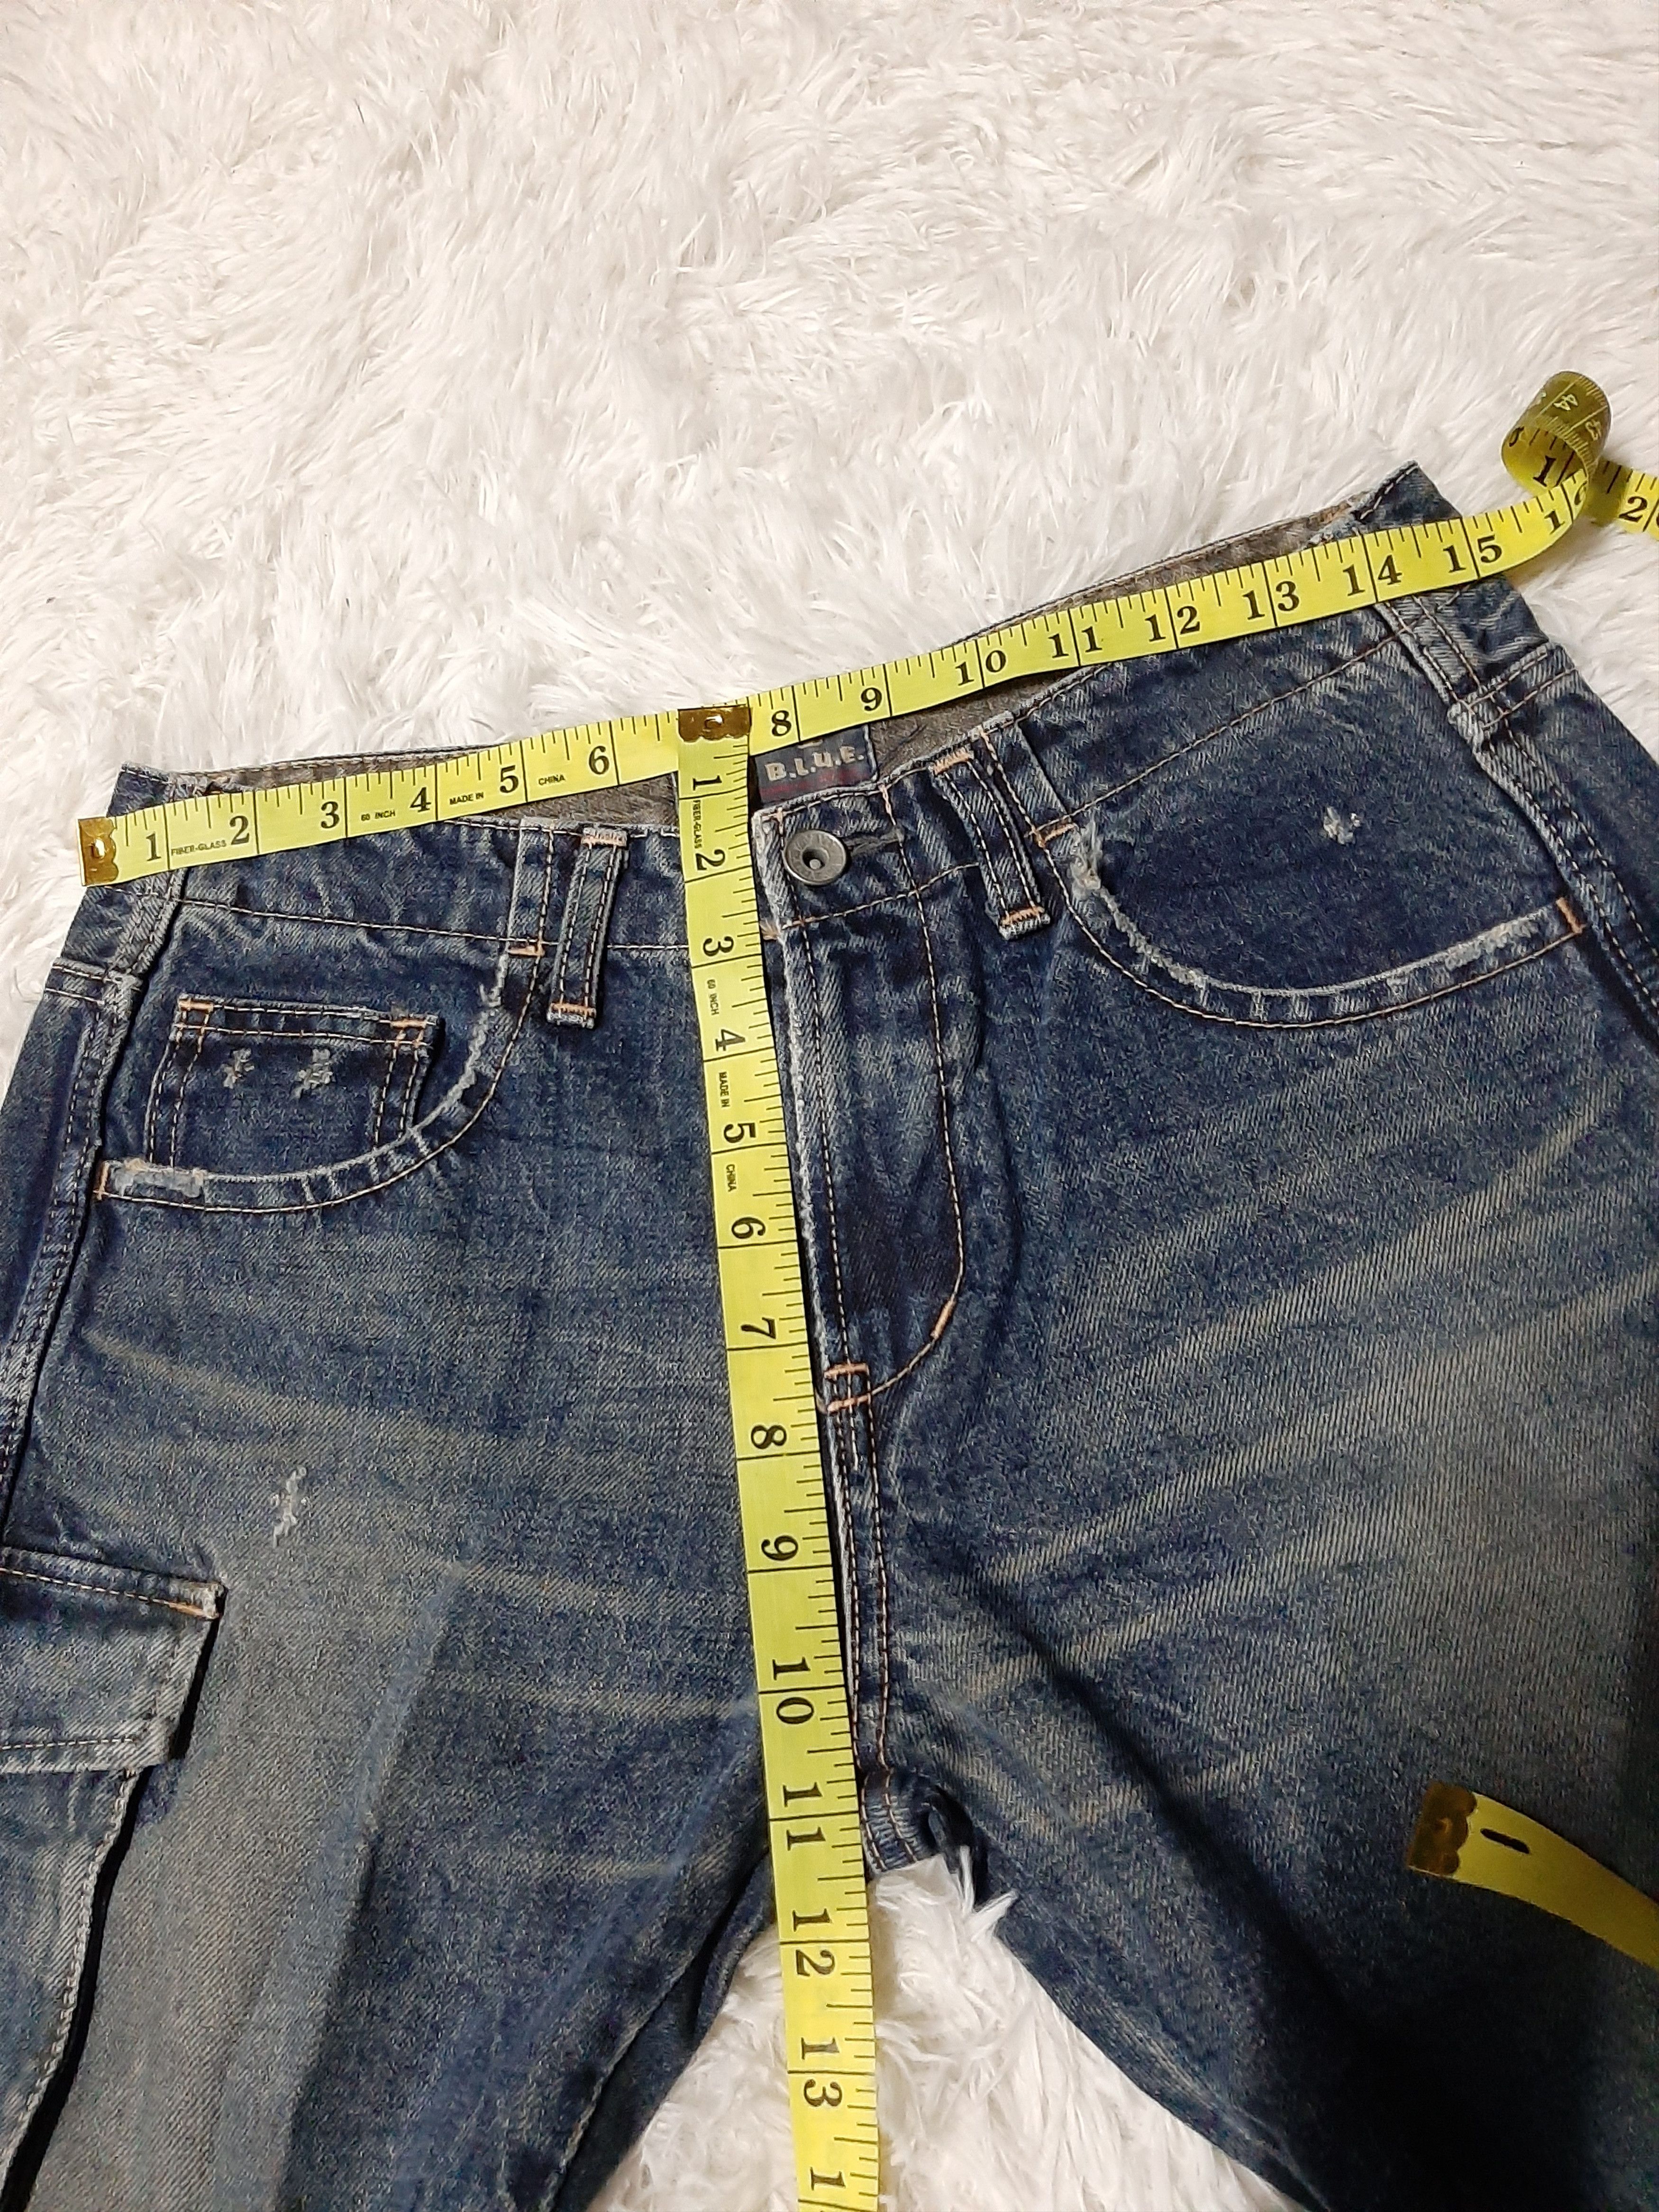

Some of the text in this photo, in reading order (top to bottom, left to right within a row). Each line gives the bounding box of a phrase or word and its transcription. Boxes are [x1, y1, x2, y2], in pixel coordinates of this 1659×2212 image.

[146, 832, 161, 862] 1
[229, 814, 251, 846] 2
[320, 801, 340, 828] 3
[410, 787, 432, 812] 4
[500, 765, 519, 793] 5
[588, 745, 610, 775] 6
[771, 710, 792, 737] 8
[860, 687, 882, 711] 9
[956, 649, 1007, 686] 10
[1048, 625, 1103, 659] 11
[1144, 606, 1200, 642] 12
[1242, 581, 1300, 620] 13
[1342, 555, 1403, 596] 14
[1443, 536, 1502, 573] 15
[765, 746, 865, 781] B.L.U.E.
[538, 774, 565, 785] CHINA
[693, 775, 722, 791] 1
[449, 791, 484, 804] MADE IN
[374, 810, 396, 819] INCH
[695, 848, 726, 871] 2
[702, 936, 734, 956] 3
[711, 993, 720, 1015] INCH
[715, 1029, 746, 1052] 4
[719, 1072, 730, 1107] MADE IN
[723, 1122, 756, 1144] 5
[726, 1164, 737, 1192] CHINA
[731, 1217, 766, 1238] 6
[741, 1317, 776, 1339] 7
[751, 1425, 787, 1449] 8
[761, 1535, 798, 1561] 9
[772, 1657, 814, 1724] 10
[783, 1781, 826, 1850] 11
[792, 1908, 835, 1976] 12
[800, 2037, 842, 2108] 13
